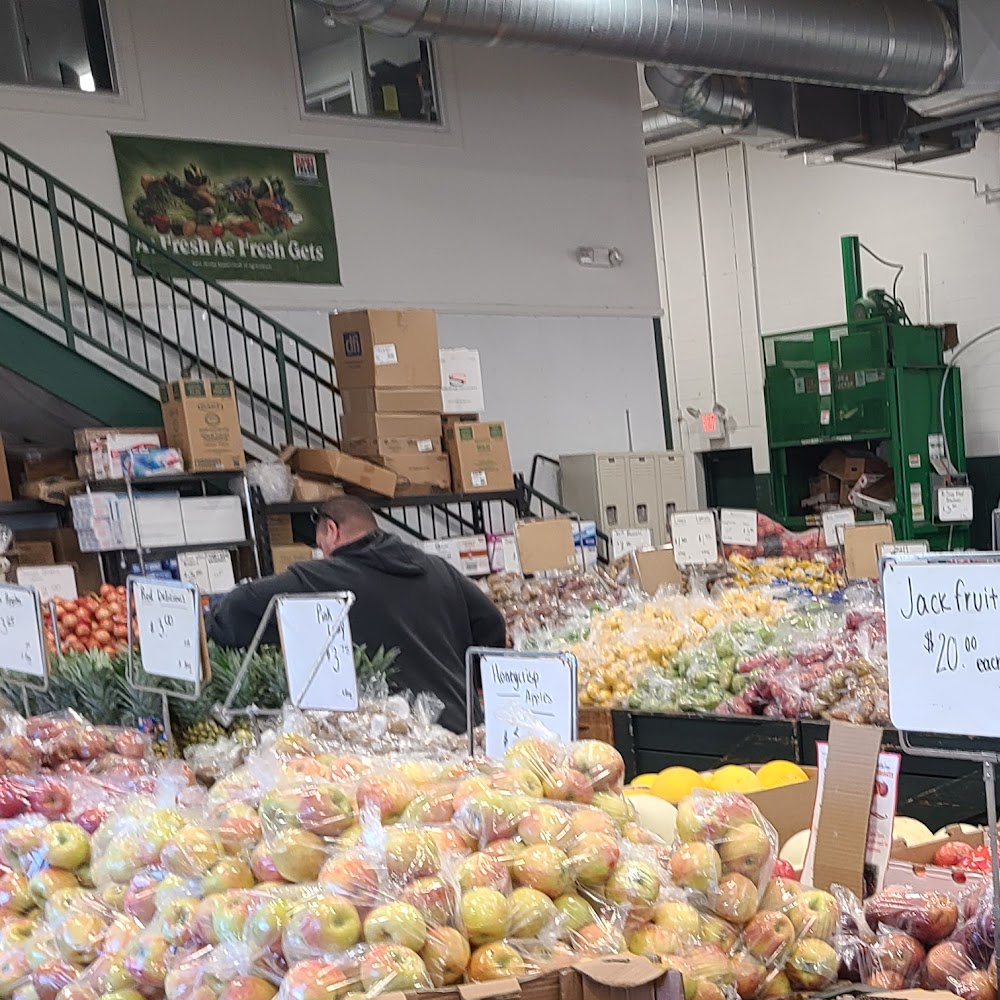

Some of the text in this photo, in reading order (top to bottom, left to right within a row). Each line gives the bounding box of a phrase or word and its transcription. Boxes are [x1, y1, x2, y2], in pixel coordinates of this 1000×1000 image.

[160, 233, 212, 256] Fresh
[214, 237, 235, 257] As
[238, 238, 287, 260] Fresh
[287, 239, 324, 262] Gets
[491, 663, 540, 692] Honeycrisp
